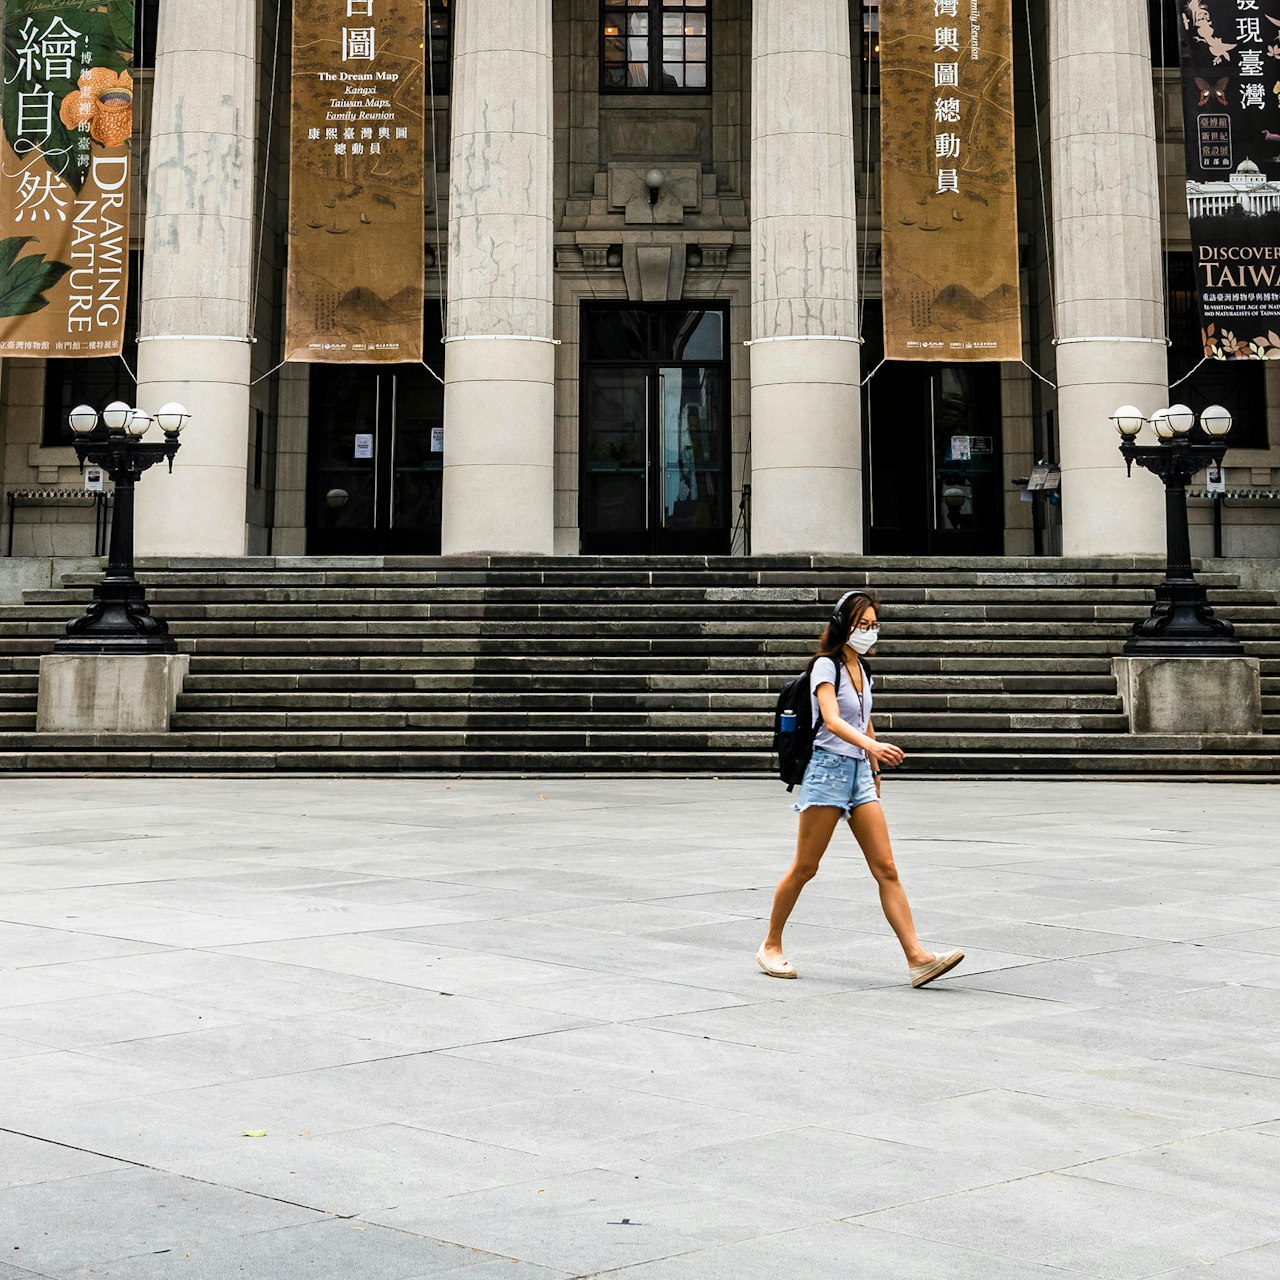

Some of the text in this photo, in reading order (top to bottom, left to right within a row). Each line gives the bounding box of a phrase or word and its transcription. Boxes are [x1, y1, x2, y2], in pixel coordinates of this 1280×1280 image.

[970, 24, 981, 60] Reunion
[317, 71, 399, 82] The Dream Map
[344, 86, 377, 96] Kangxi
[329, 98, 392, 108] Taiwan Maps,
[2, 15, 82, 223] 繪自然
[325, 111, 395, 122] Family Reunion
[308, 127, 408, 140] 康熙臺灣輿圖
[334, 142, 381, 155] 總動員
[92, 155, 128, 327] DRAWING
[67, 199, 98, 333] NATURE
